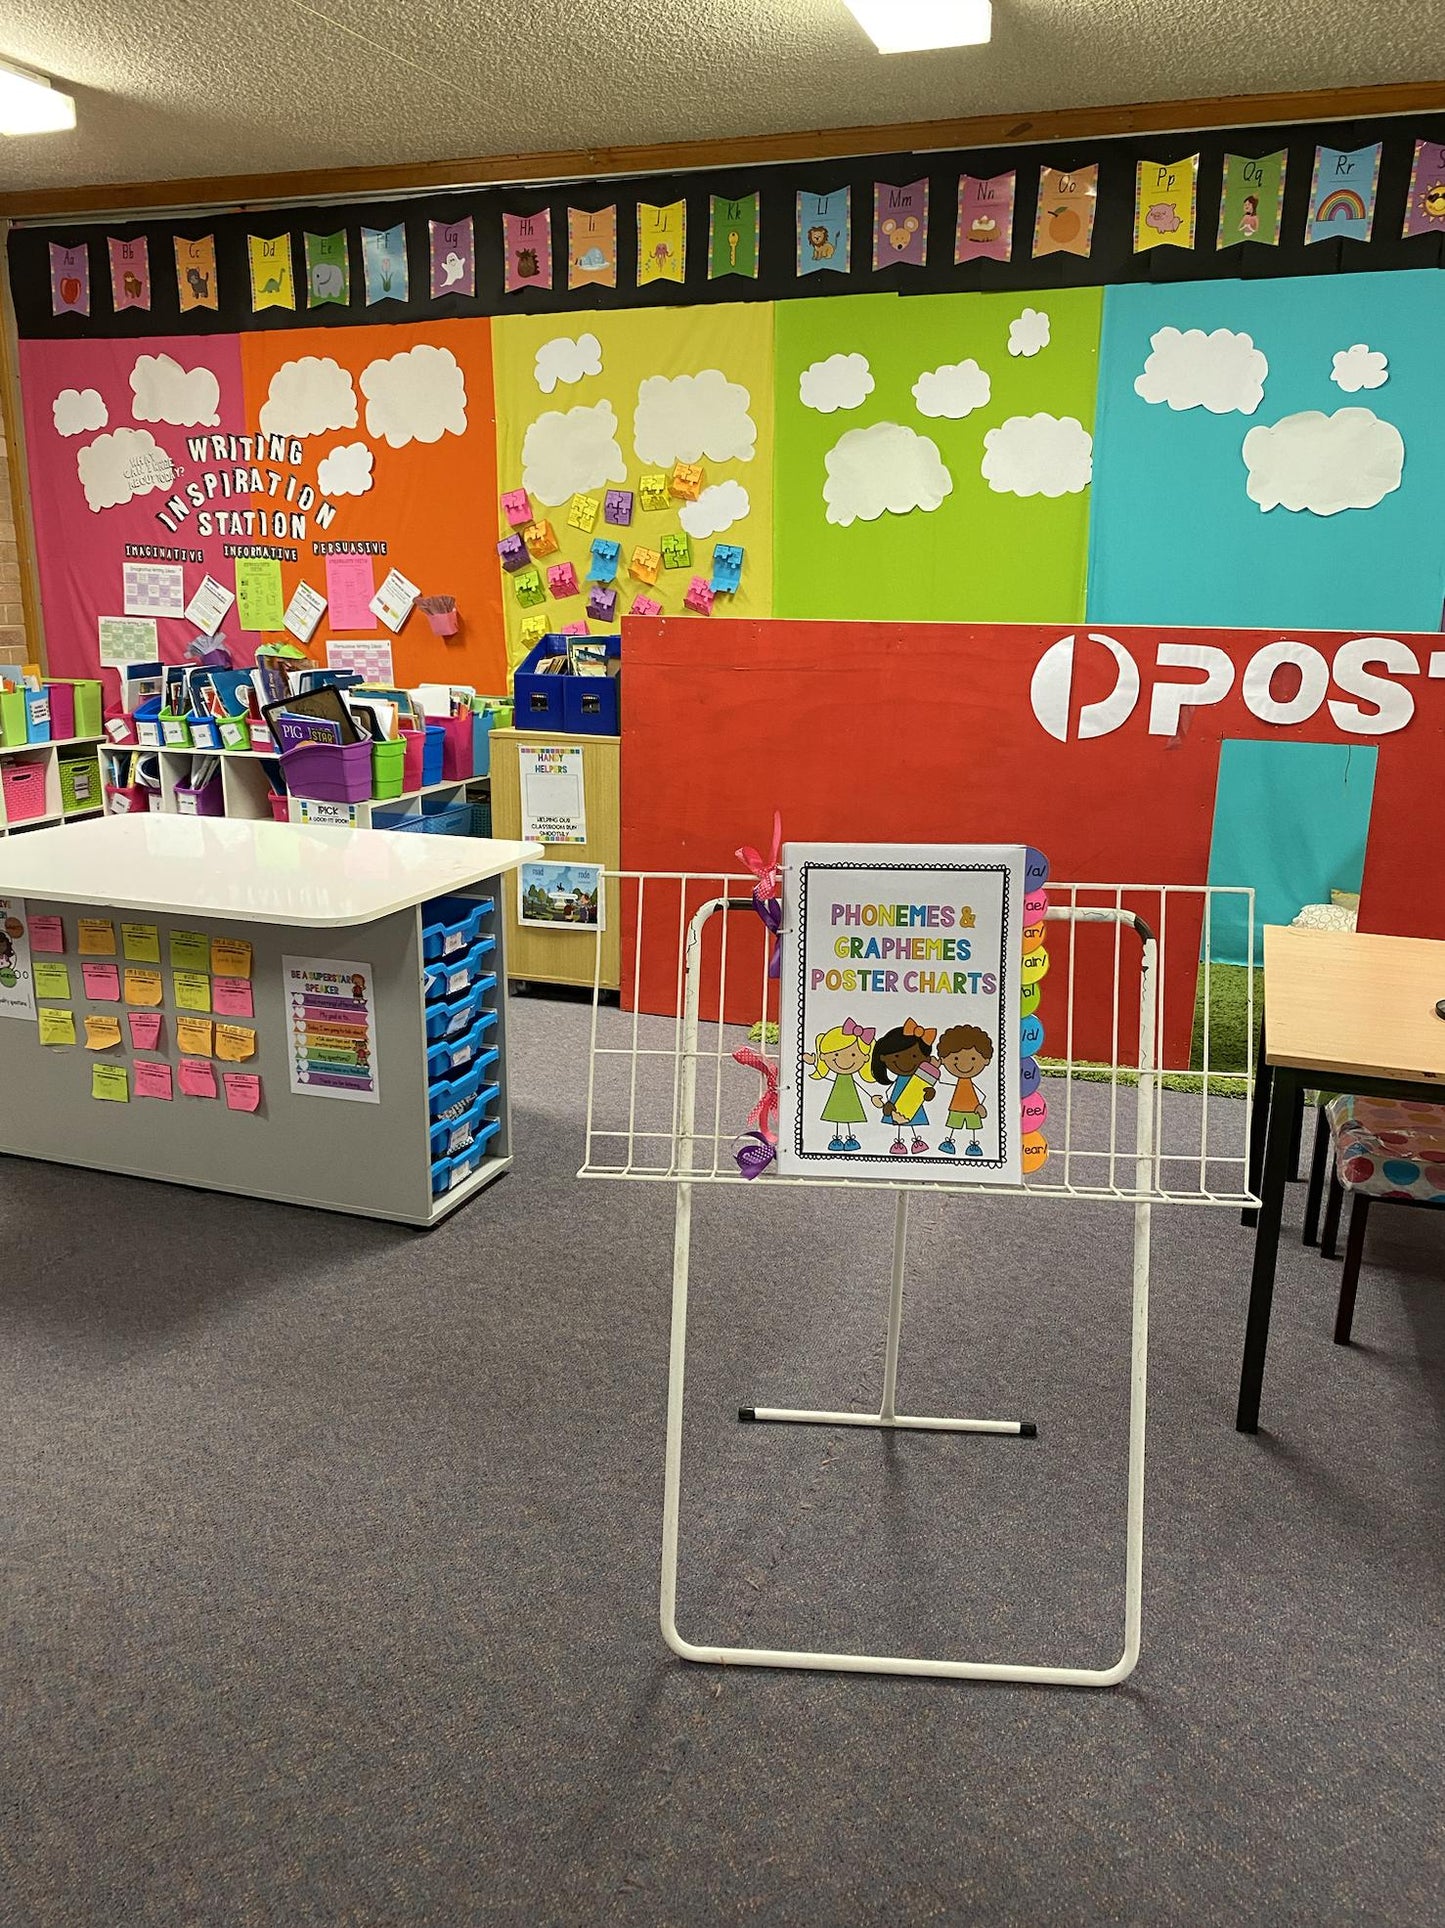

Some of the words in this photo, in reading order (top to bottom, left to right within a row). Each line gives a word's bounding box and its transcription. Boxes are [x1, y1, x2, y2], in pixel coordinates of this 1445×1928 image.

[1335, 154, 1355, 175] Rr
[1157, 167, 1175, 191] Pp
[1243, 161, 1263, 187] Qq
[977, 181, 995, 201] Nn
[1058, 174, 1077, 193] Oo
[889, 189, 912, 208] Mm
[727, 202, 741, 220] Kk
[520, 219, 534, 236] Hh
[444, 226, 458, 248] Gg
[63, 250, 75, 265] Aa
[122, 243, 134, 259] Bb
[263, 242, 275, 257] Dd
[188, 433, 303, 465] WRITING
[156, 466, 337, 533] INSPIRATION
[198, 510, 307, 540] STATION
[125, 544, 203, 562] IMAGINATIVE
[224, 544, 297, 561] INFORMATIVE
[312, 542, 387, 554] PERSUASIVE
[281, 724, 303, 739] PIG
[535, 764, 568, 774] HELPERS
[317, 805, 339, 815] PICK
[830, 903, 955, 928] PHONEMES
[958, 905, 977, 929] &
[833, 937, 972, 961] GRAPHEMES
[291, 970, 301, 979] BE
[810, 968, 899, 993] POSTER
[903, 970, 998, 996] CHARTS
[1021, 1028, 1039, 1042] /d/
